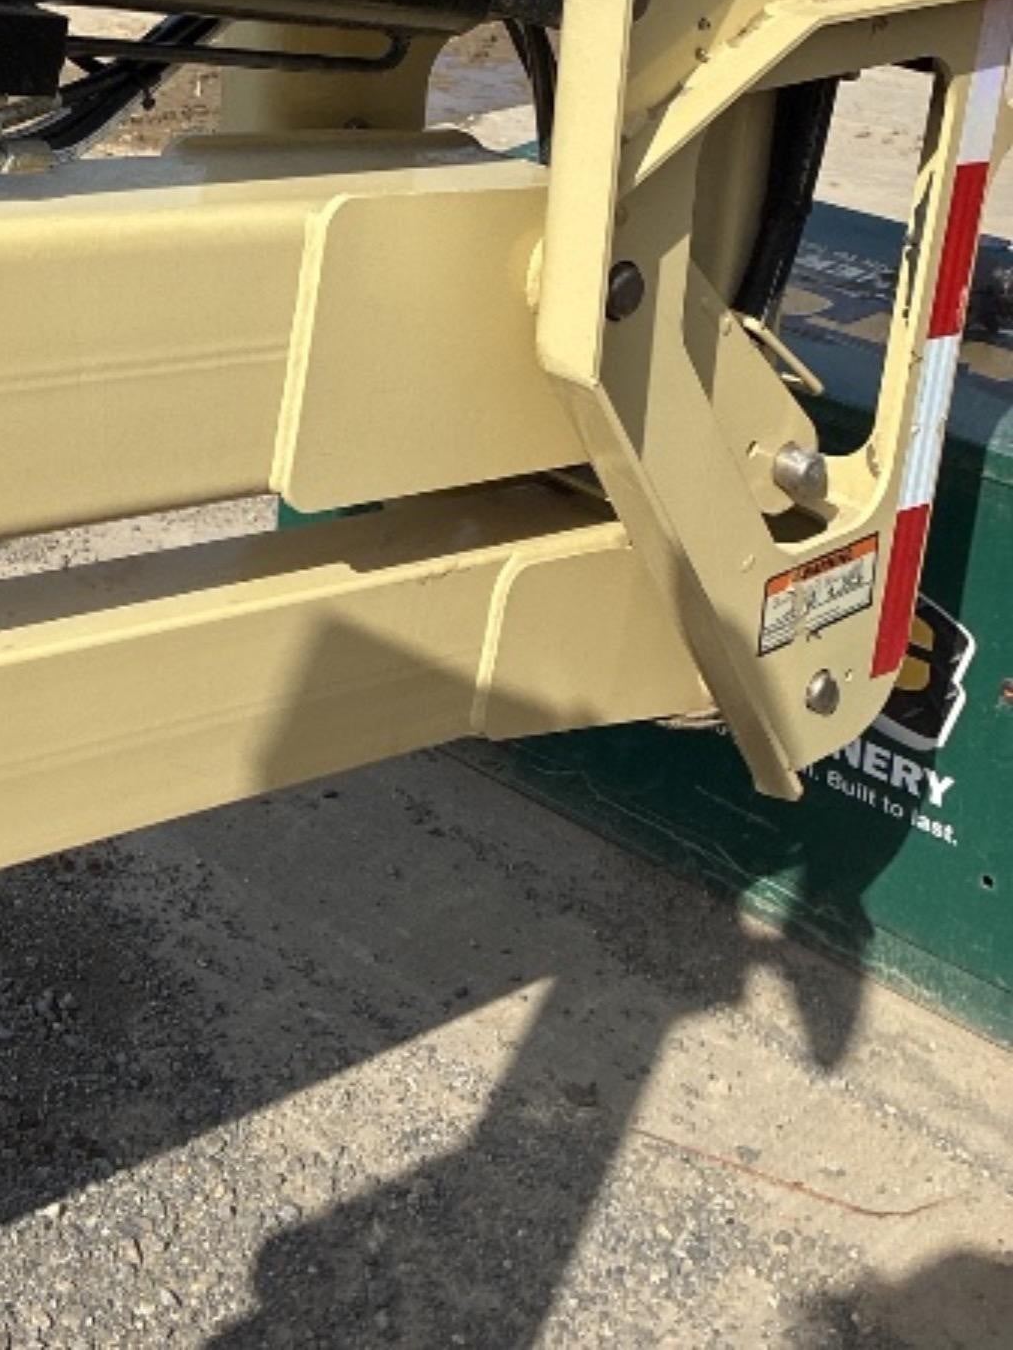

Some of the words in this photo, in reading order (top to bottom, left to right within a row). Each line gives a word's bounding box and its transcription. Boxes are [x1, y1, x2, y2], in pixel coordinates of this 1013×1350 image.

[826, 769, 877, 808] Built
[882, 793, 905, 819] to
[910, 808, 959, 847] last.
